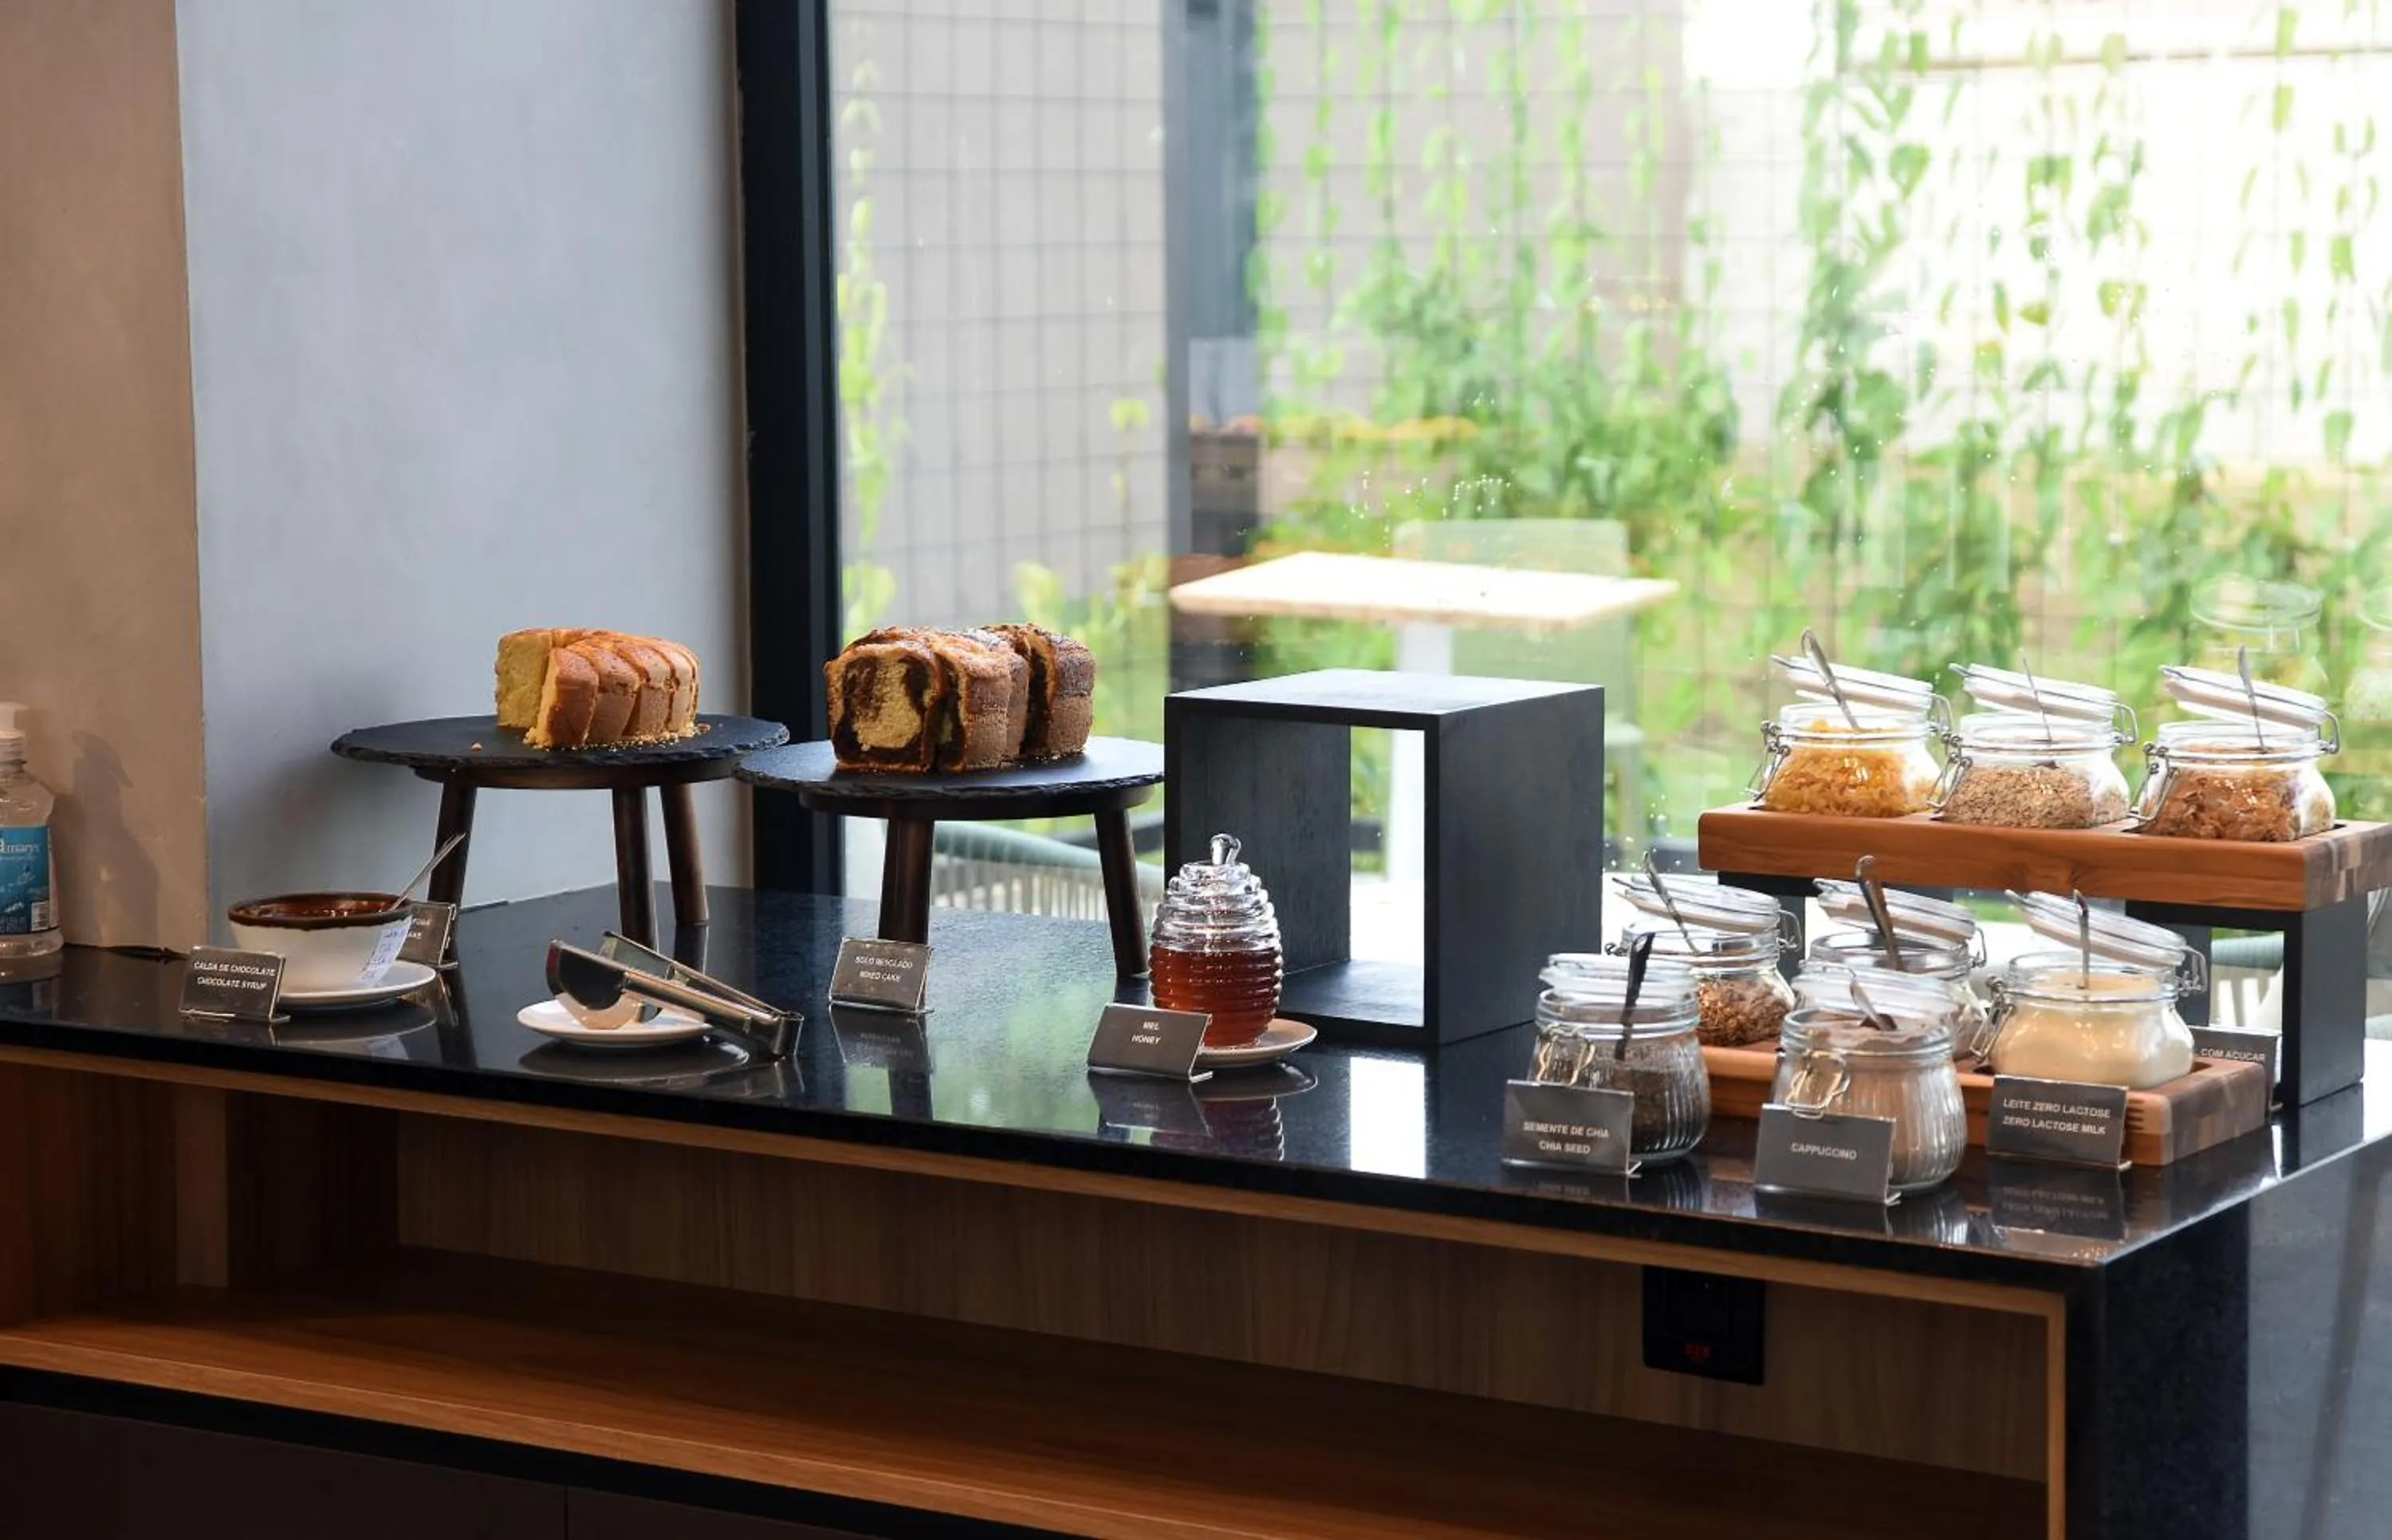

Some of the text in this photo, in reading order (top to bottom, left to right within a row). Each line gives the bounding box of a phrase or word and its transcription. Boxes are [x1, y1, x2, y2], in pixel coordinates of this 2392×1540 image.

[231, 964, 275, 976] CHOCOLATE
[197, 976, 267, 991] CHOCOLATE SYRUP
[1143, 1020, 1159, 1031] MEL
[1131, 1034, 1162, 1044] HONEY
[2201, 1048, 2224, 1059] COM
[2003, 1098, 2111, 1118] LEITE ZERO LACTOSE
[1524, 1122, 1610, 1138] SEMENTE DE CHIA
[2002, 1115, 2106, 1135] ZERO LACTOSE MILK
[1539, 1140, 1591, 1154] CHIA SEED
[1791, 1142, 1858, 1161] CAPPUCCINO
